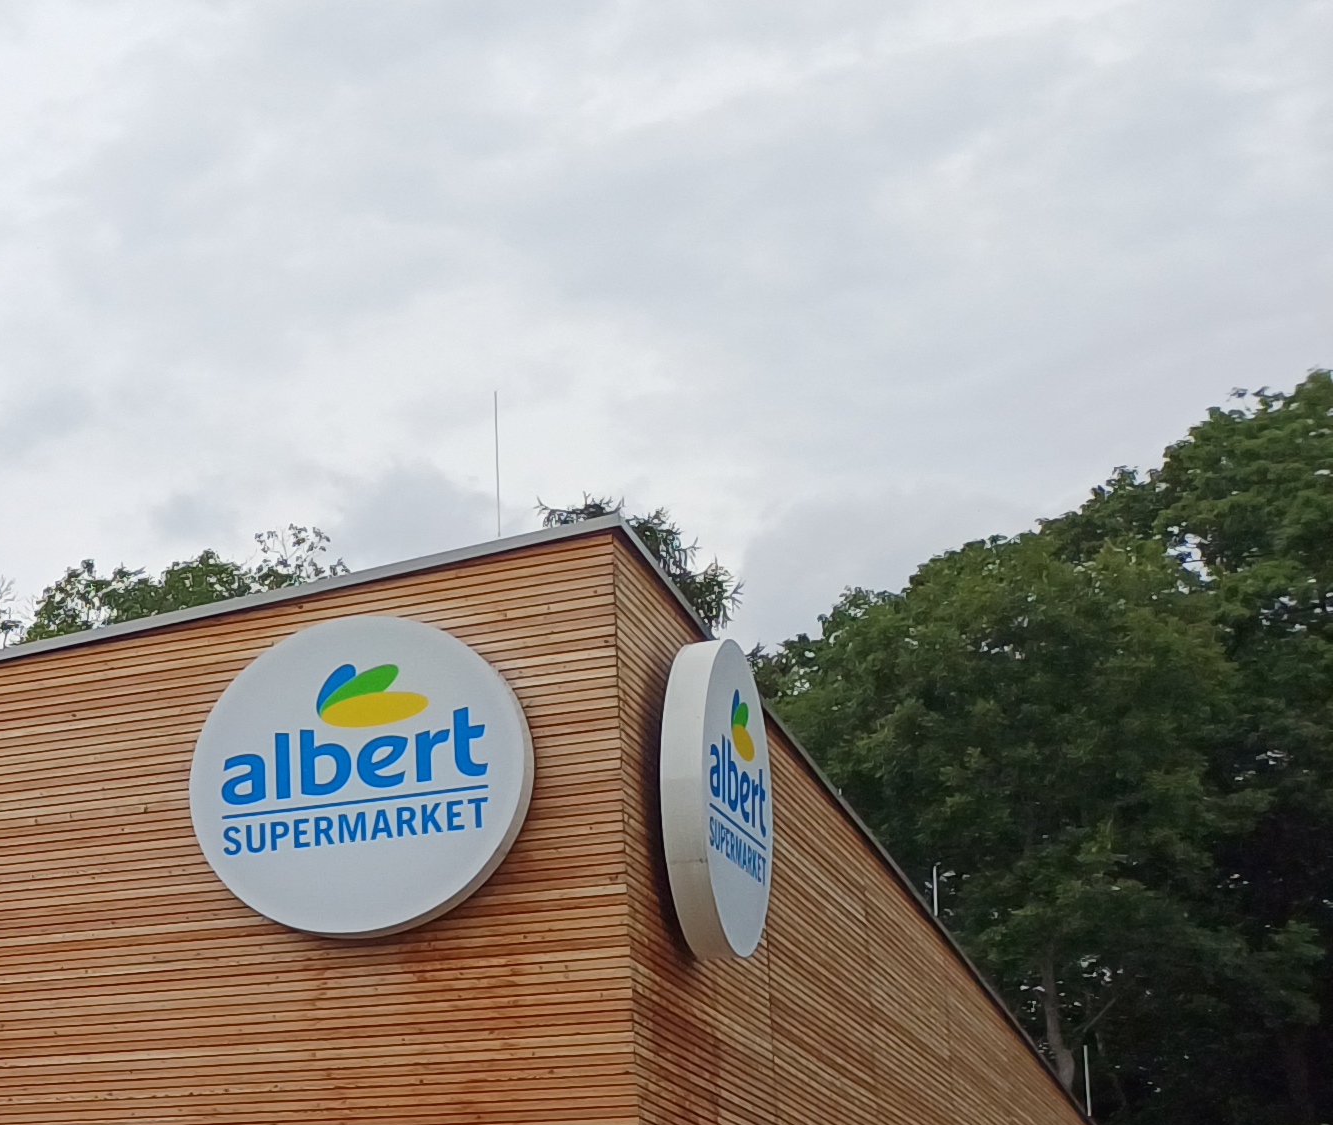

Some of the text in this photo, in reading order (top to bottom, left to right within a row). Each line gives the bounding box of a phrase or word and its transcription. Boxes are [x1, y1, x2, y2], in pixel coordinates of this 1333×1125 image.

[221, 707, 489, 806] albert
[709, 733, 767, 838] albert
[223, 797, 489, 856] SUPERMARKET
[709, 816, 767, 886] SUPERMARKET
